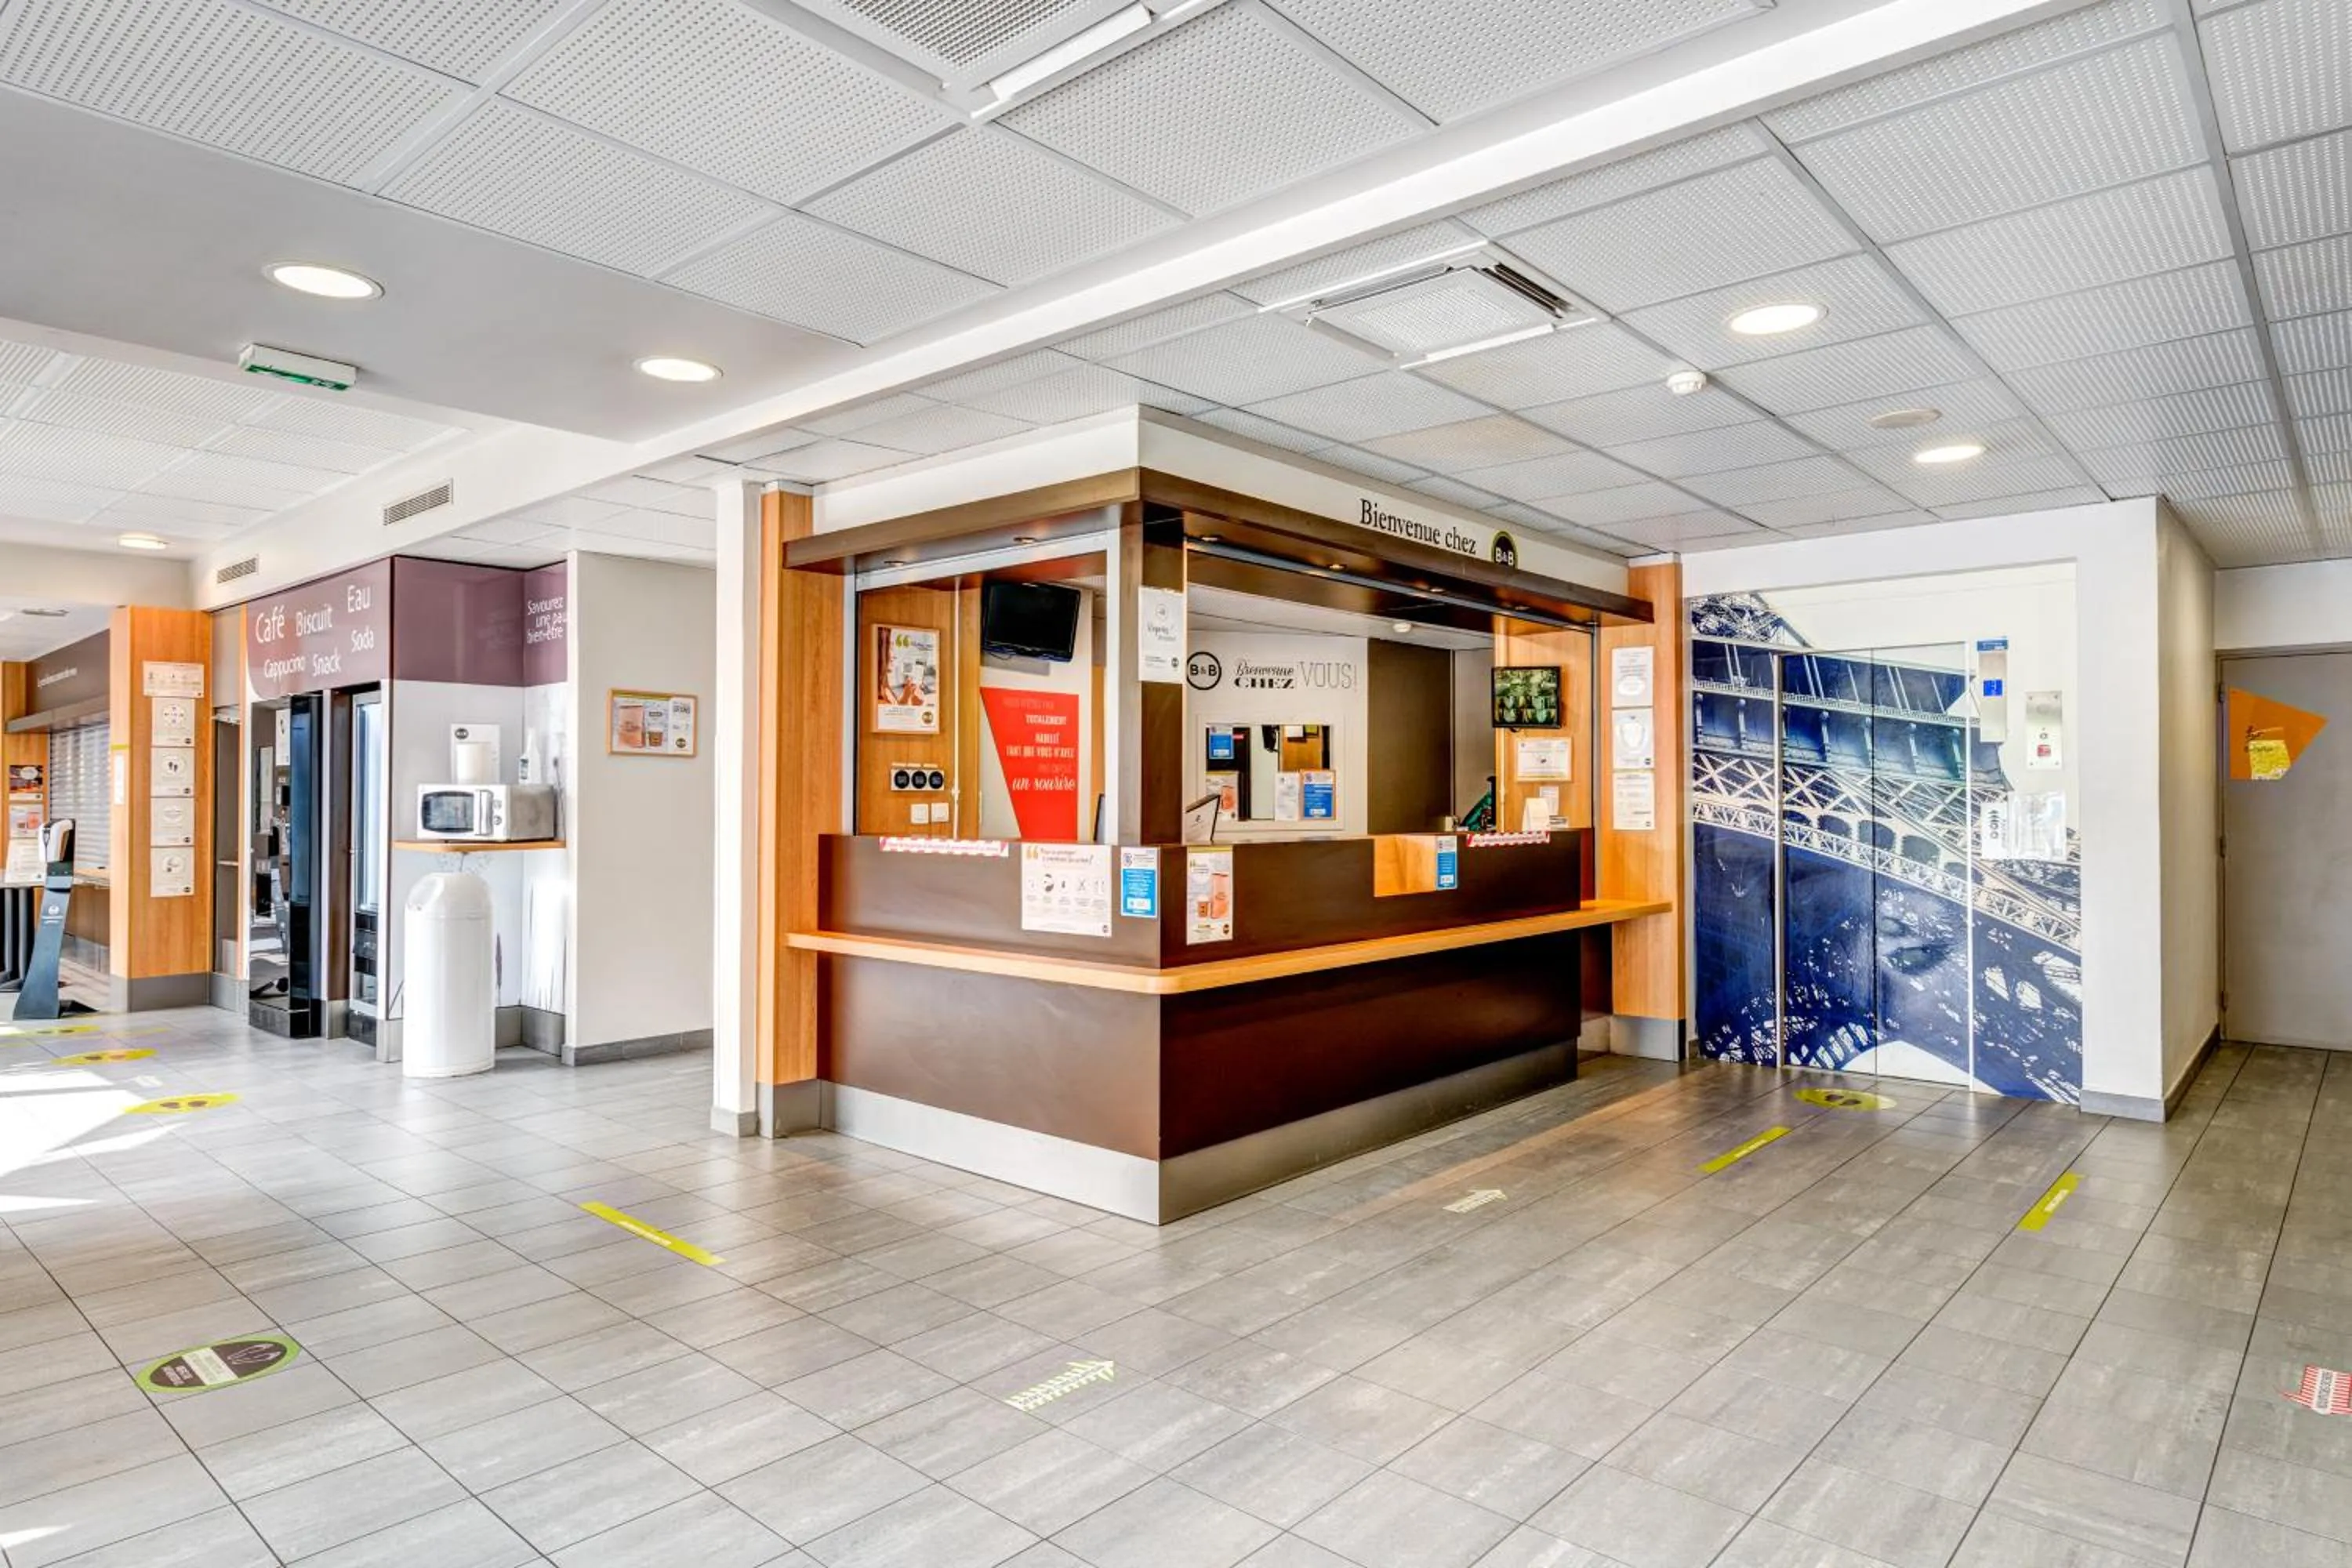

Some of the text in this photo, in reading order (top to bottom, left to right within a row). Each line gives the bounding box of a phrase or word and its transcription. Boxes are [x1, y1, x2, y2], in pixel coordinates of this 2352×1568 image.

[1360, 499, 1515, 567] Bienvenue chez B&B
[347, 585, 372, 613] Eau
[255, 604, 285, 644] Café
[296, 603, 333, 637] Biscuit
[350, 625, 374, 653] Soda
[313, 648, 341, 677] Snack
[1236, 659, 1294, 677] Bienvenue
[1234, 677, 1295, 689] CHEZ
[1012, 774, 1076, 791] un sourire
